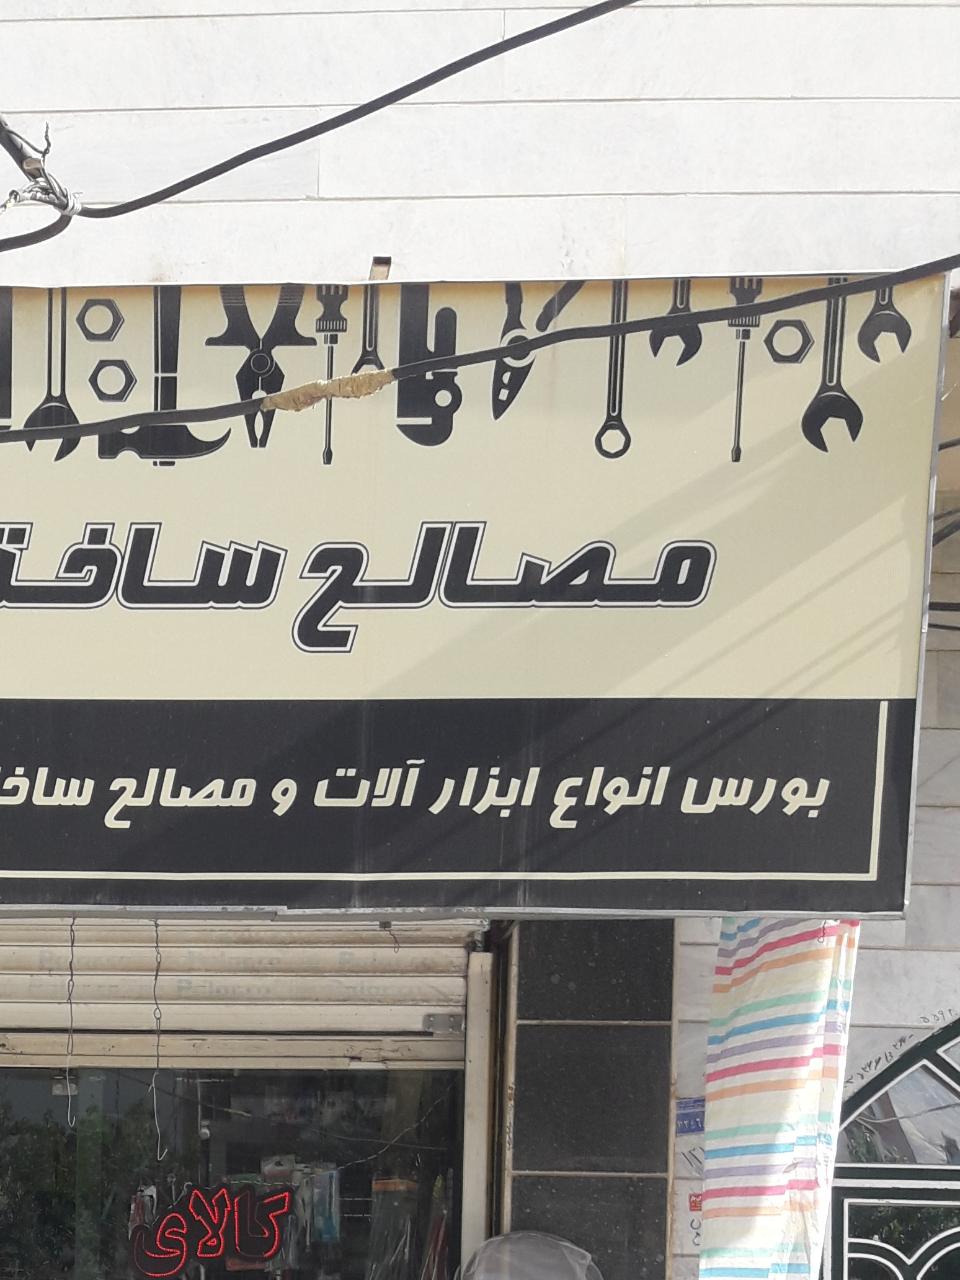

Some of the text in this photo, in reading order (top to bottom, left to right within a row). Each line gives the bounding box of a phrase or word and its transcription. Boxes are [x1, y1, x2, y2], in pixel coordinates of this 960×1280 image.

[292, 521, 717, 653] مصالح
[104, 767, 257, 829] مصالح
[270, 778, 298, 817] و
[313, 758, 425, 807] آلات
[427, 766, 541, 818] ابزار
[548, 766, 671, 829] انواع
[680, 776, 831, 818] بورس
